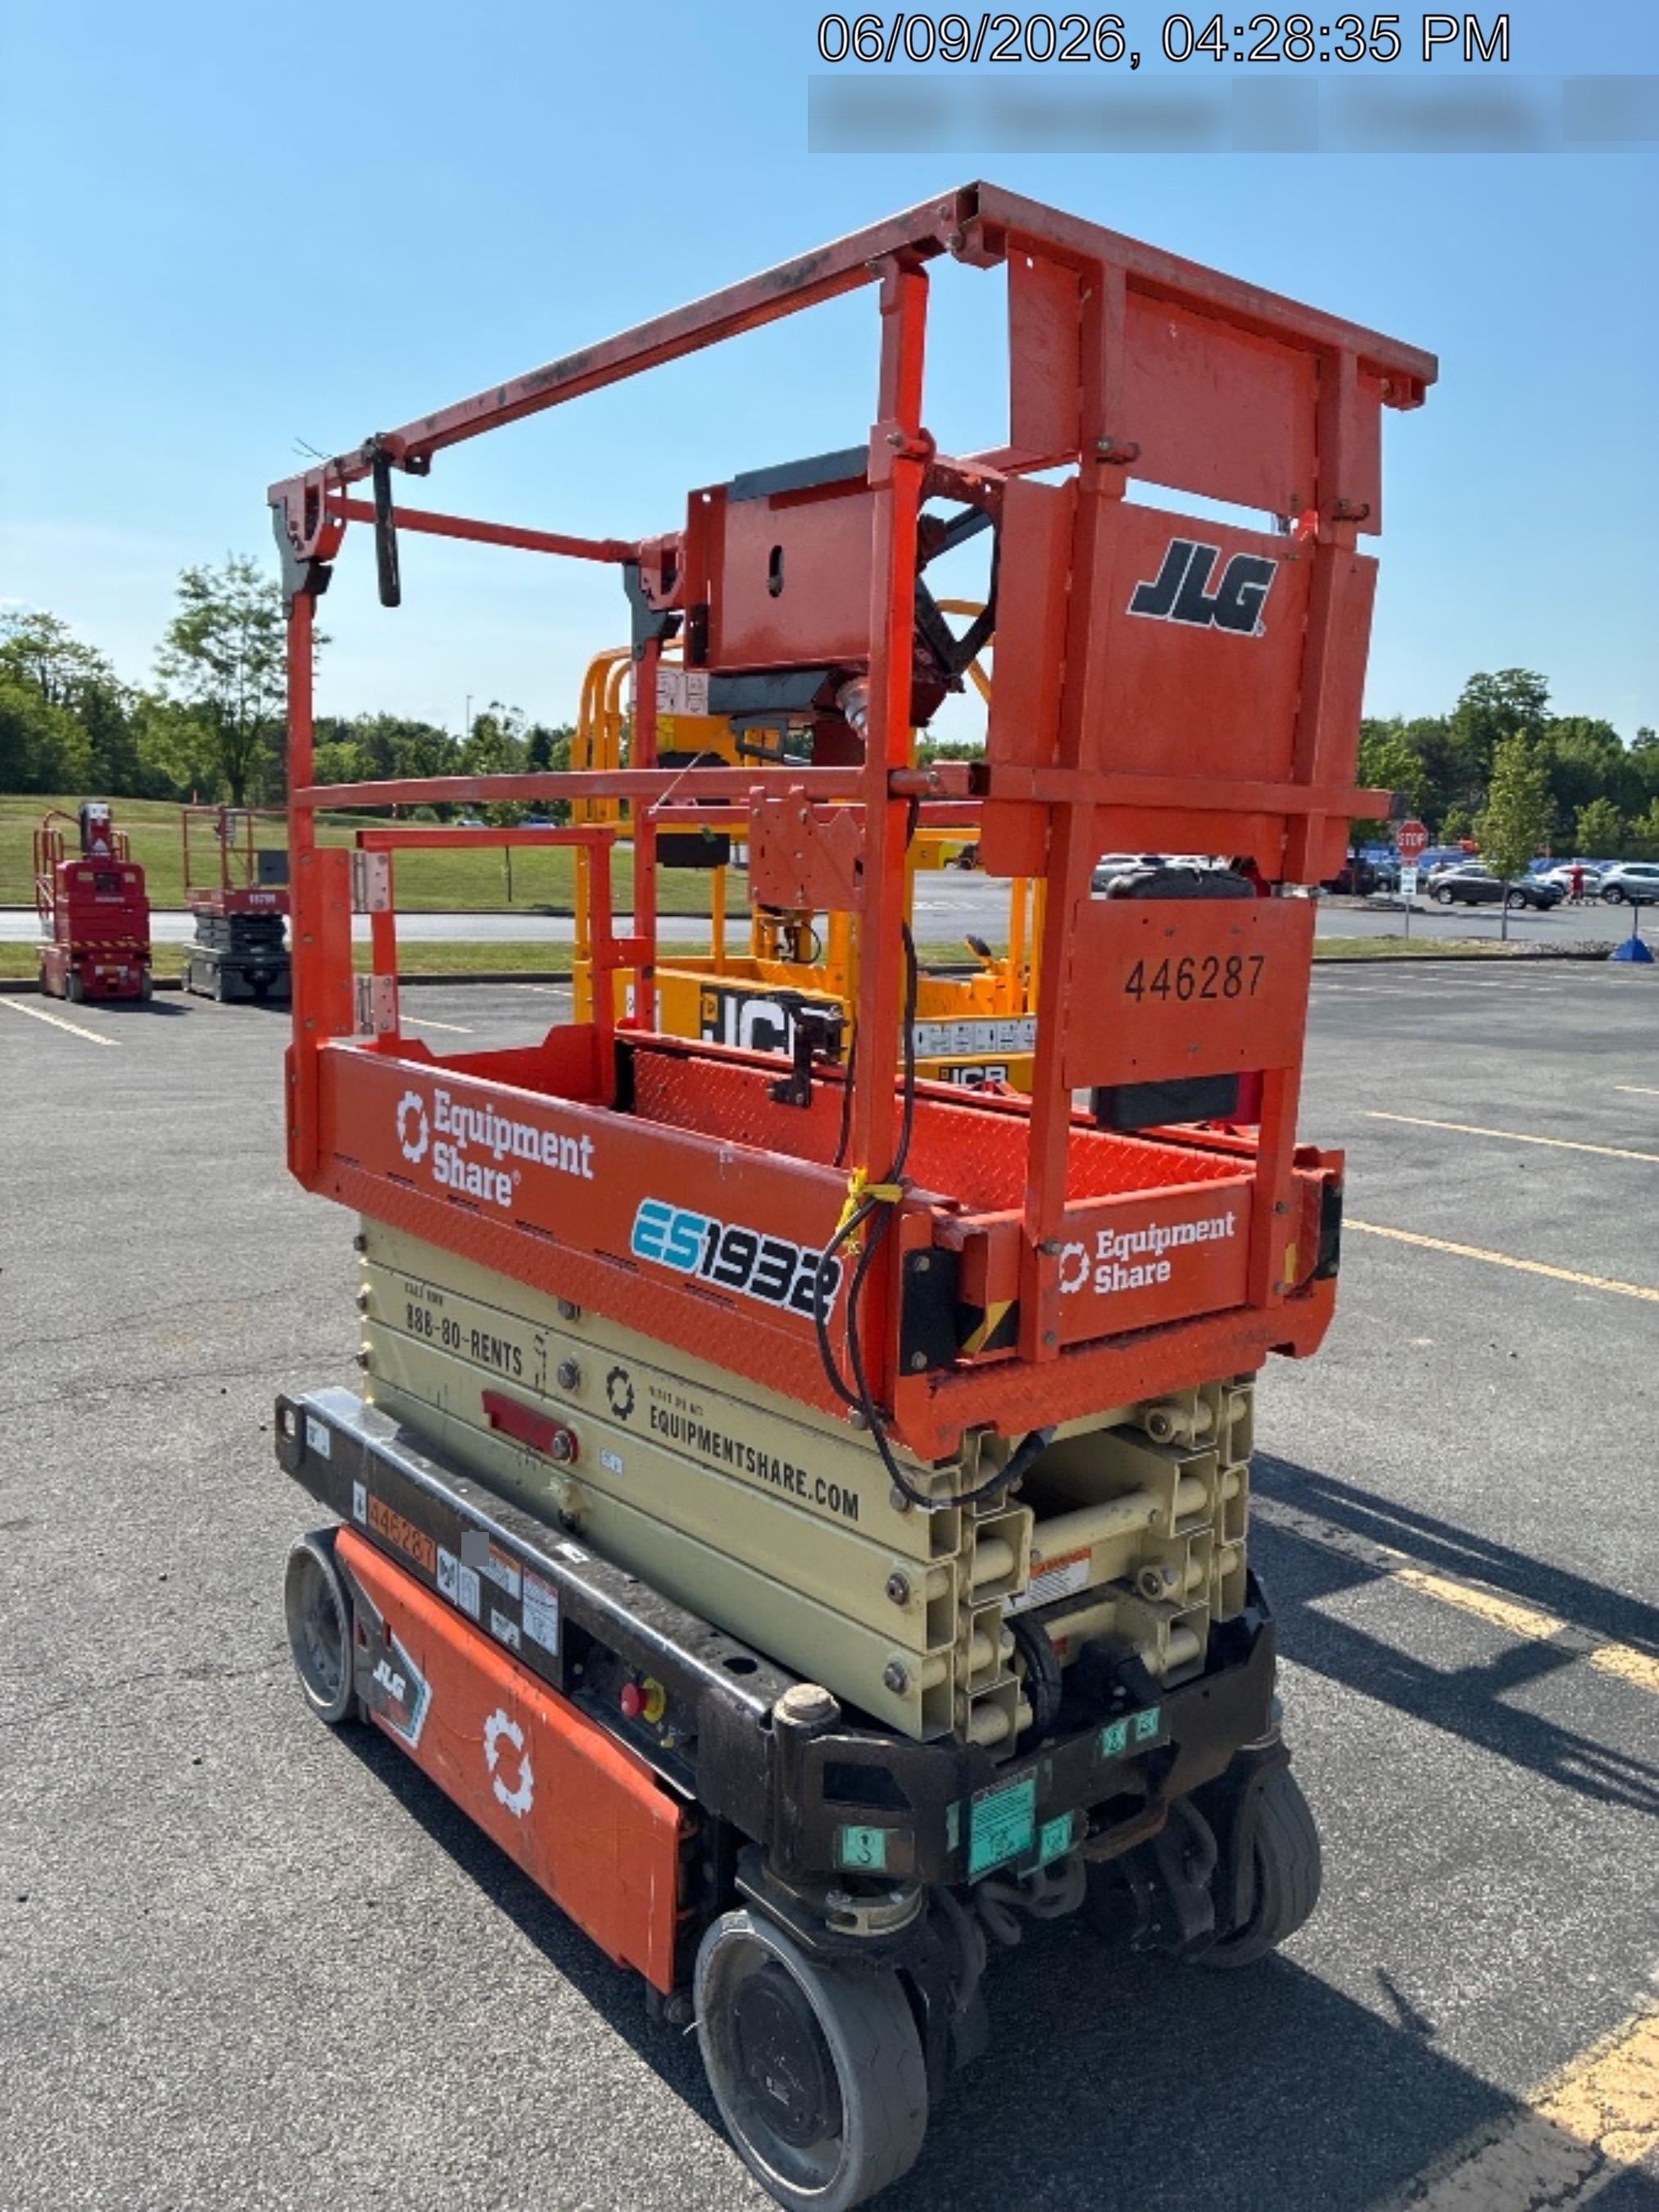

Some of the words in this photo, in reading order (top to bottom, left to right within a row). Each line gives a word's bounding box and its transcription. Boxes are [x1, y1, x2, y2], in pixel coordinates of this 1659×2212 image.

[1126, 537, 1276, 636] JLG
[1398, 832, 1425, 847] STOP
[1124, 955, 1265, 1003] 446287
[433, 1088, 596, 1180] Equipment
[630, 1196, 844, 1326] ES1932
[1095, 1211, 1237, 1262] Equipment
[1094, 1259, 1172, 1294] Share
[650, 1405, 859, 1521] EQUIPMENTSHARE.COM
